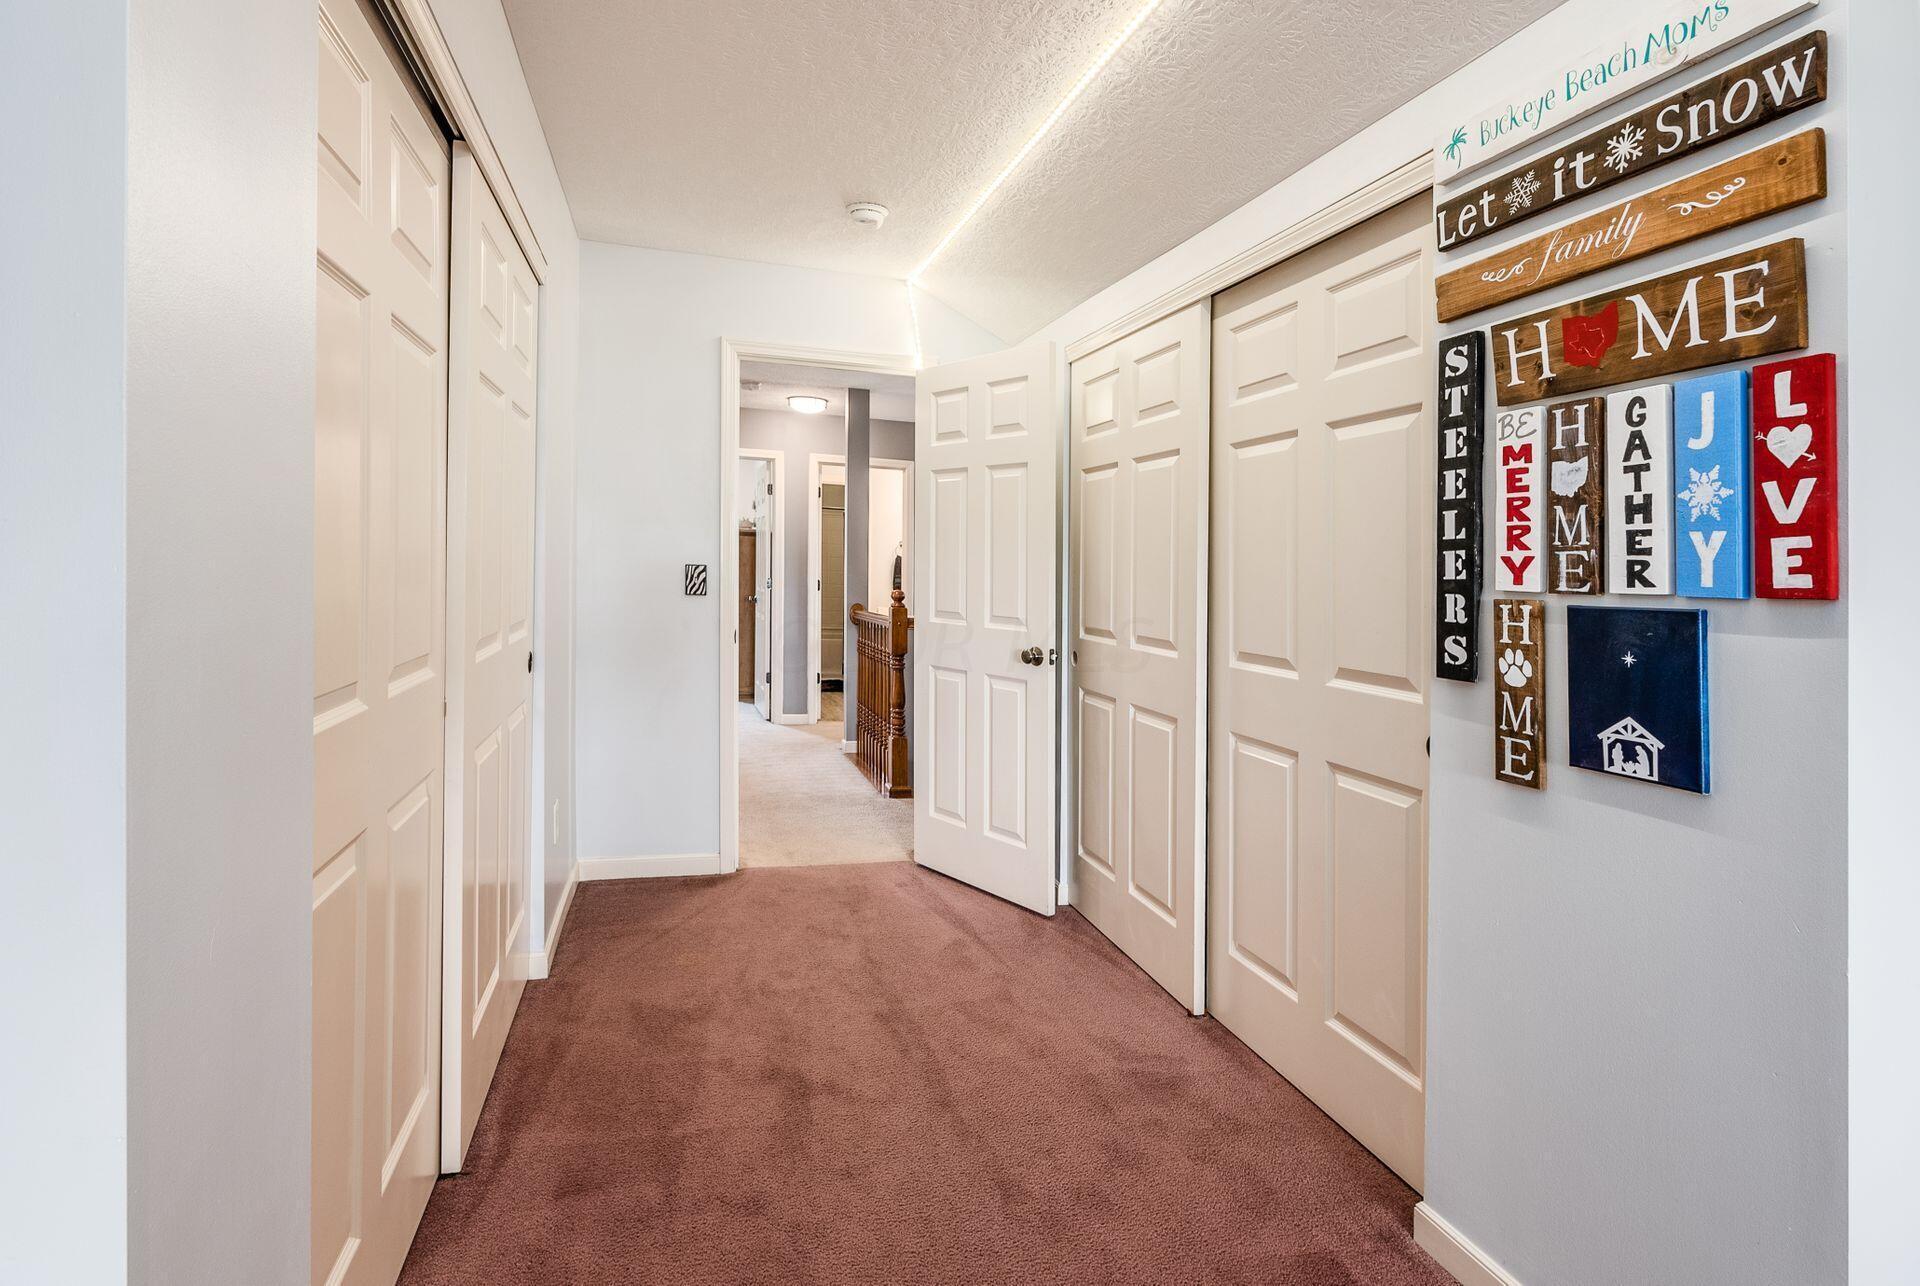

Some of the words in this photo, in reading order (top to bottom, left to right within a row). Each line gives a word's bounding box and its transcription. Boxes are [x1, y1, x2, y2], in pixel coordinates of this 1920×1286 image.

[1565, 40, 1637, 102] Beach
[1437, 189, 1499, 249] Let
[1551, 151, 1598, 201] it
[1526, 202, 1647, 287] family
[1501, 260, 1778, 388] HME
[1442, 344, 1470, 666] STEELERS
[1497, 411, 1538, 441] BE
[1551, 403, 1592, 593] HME
[1622, 395, 1657, 589] GATHER
[1679, 391, 1734, 588] JY
[1758, 370, 1818, 590] LVE
[1500, 443, 1537, 586] MERRY
[1498, 604, 1534, 782] HME
